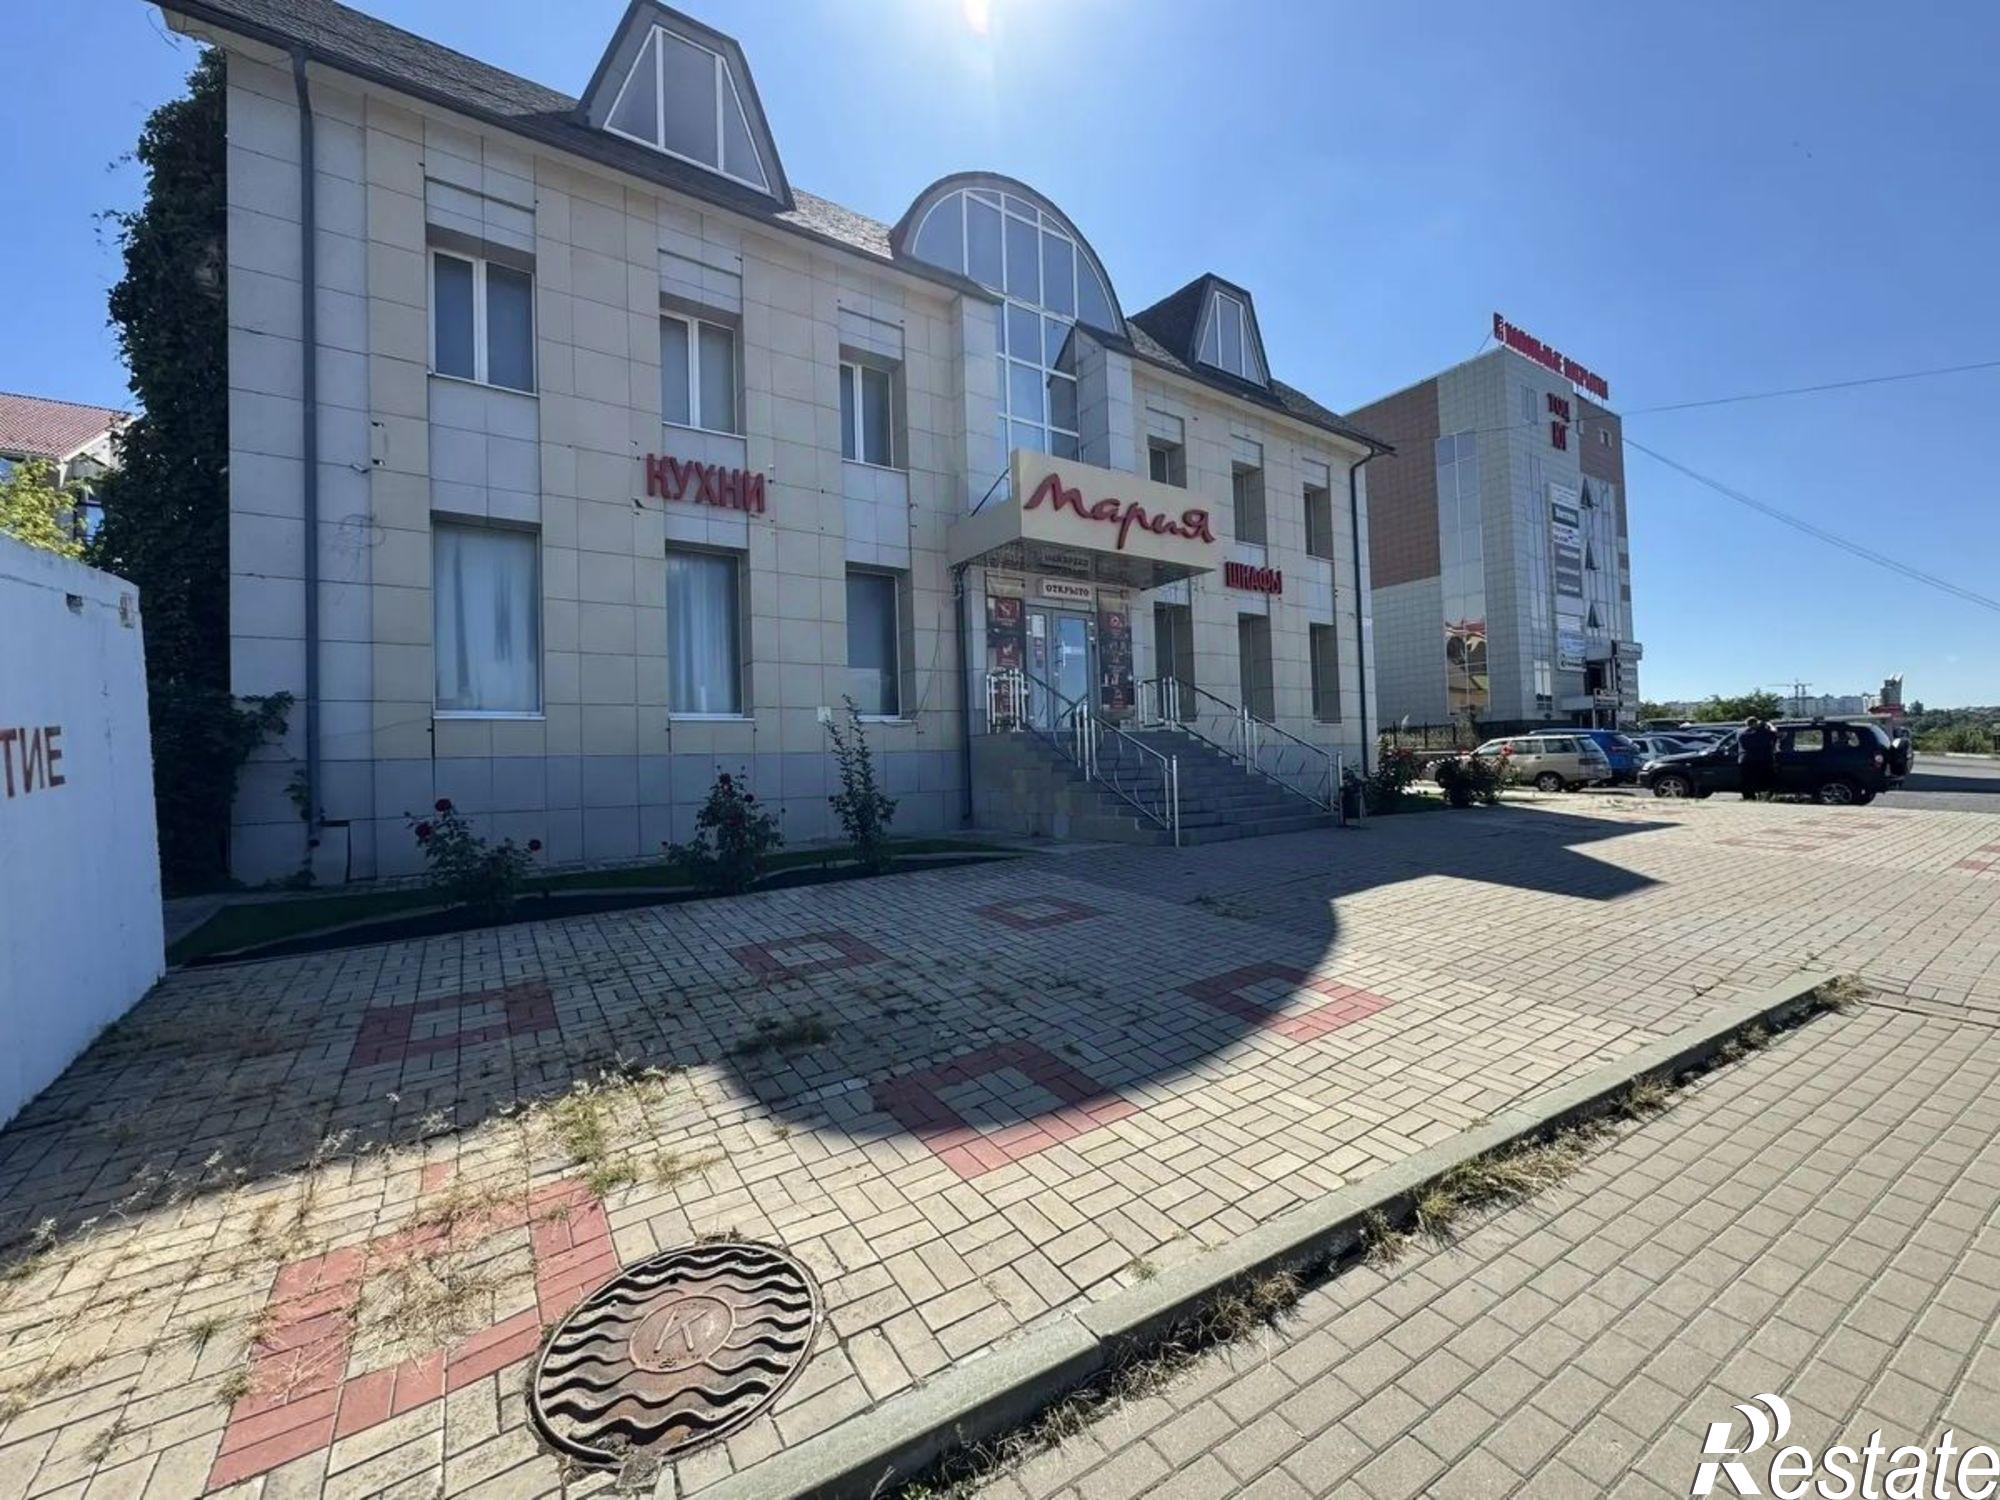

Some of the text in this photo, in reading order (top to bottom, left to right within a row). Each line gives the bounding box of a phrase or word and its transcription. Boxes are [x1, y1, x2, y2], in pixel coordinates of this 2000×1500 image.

[646, 453, 765, 513] КУХНИ
[1045, 584, 1089, 597] ОТКРЫТО
[1224, 561, 1282, 594] ШКАФЫ
